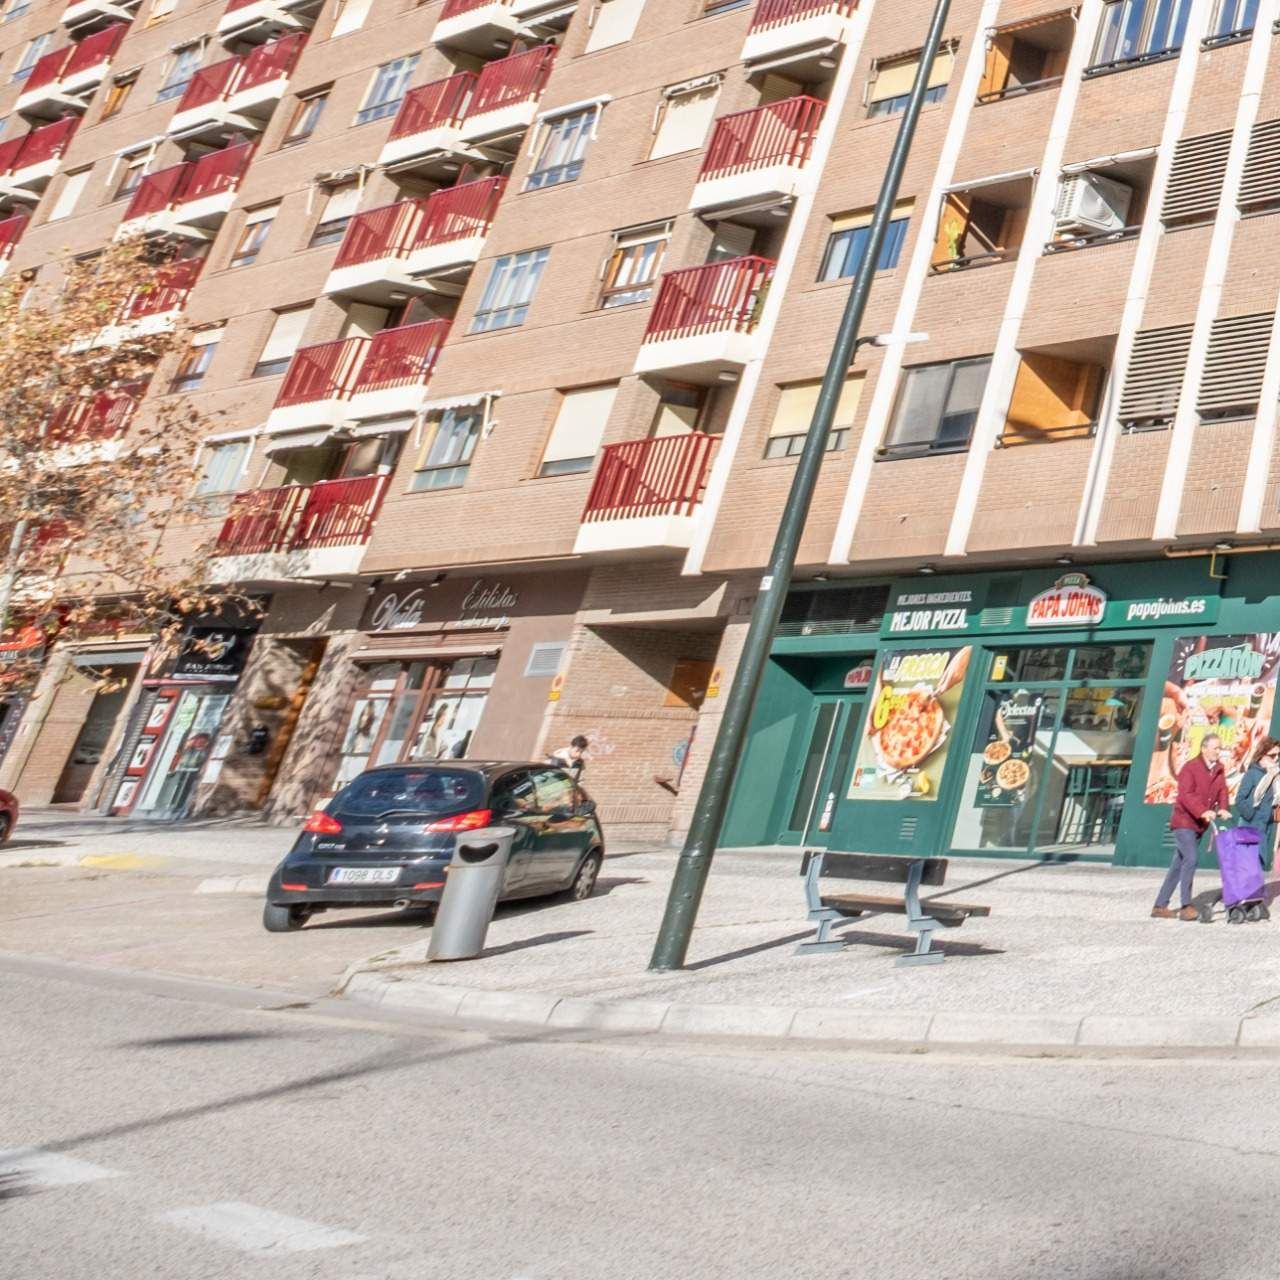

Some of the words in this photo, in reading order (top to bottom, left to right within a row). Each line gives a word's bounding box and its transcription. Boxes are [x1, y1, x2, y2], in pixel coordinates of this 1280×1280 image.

[1031, 593, 1063, 619] PAPA
[1061, 591, 1103, 618] JOHNS
[1126, 597, 1207, 621] papajohns.es
[889, 611, 931, 632] MEJOR
